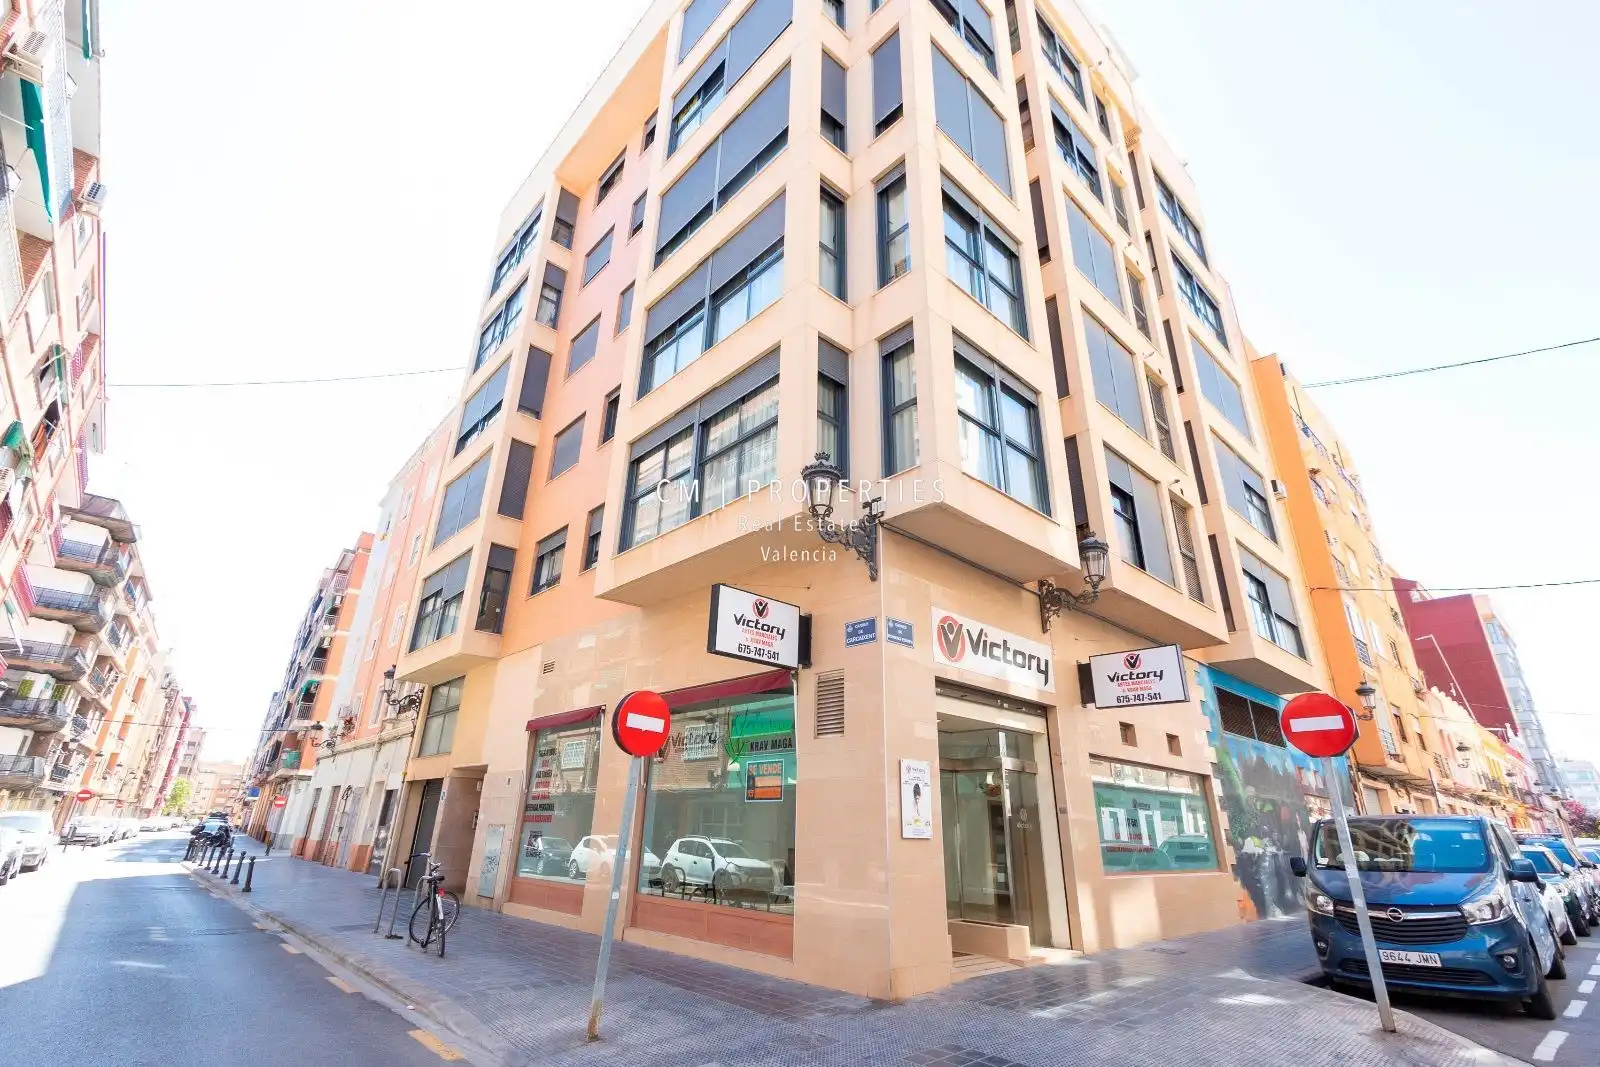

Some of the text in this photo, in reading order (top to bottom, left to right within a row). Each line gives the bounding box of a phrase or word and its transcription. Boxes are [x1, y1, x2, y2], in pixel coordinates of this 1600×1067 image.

[733, 613, 786, 641] Victory
[737, 643, 780, 661] 675-747-541
[966, 627, 1049, 687] Victory
[1106, 669, 1164, 682] Victory
[1116, 692, 1162, 703] 675-747-541
[750, 738, 792, 752] KRAV MAGA
[748, 762, 782, 776] SE VENDE
[1382, 951, 1438, 964] 9644 JMN
